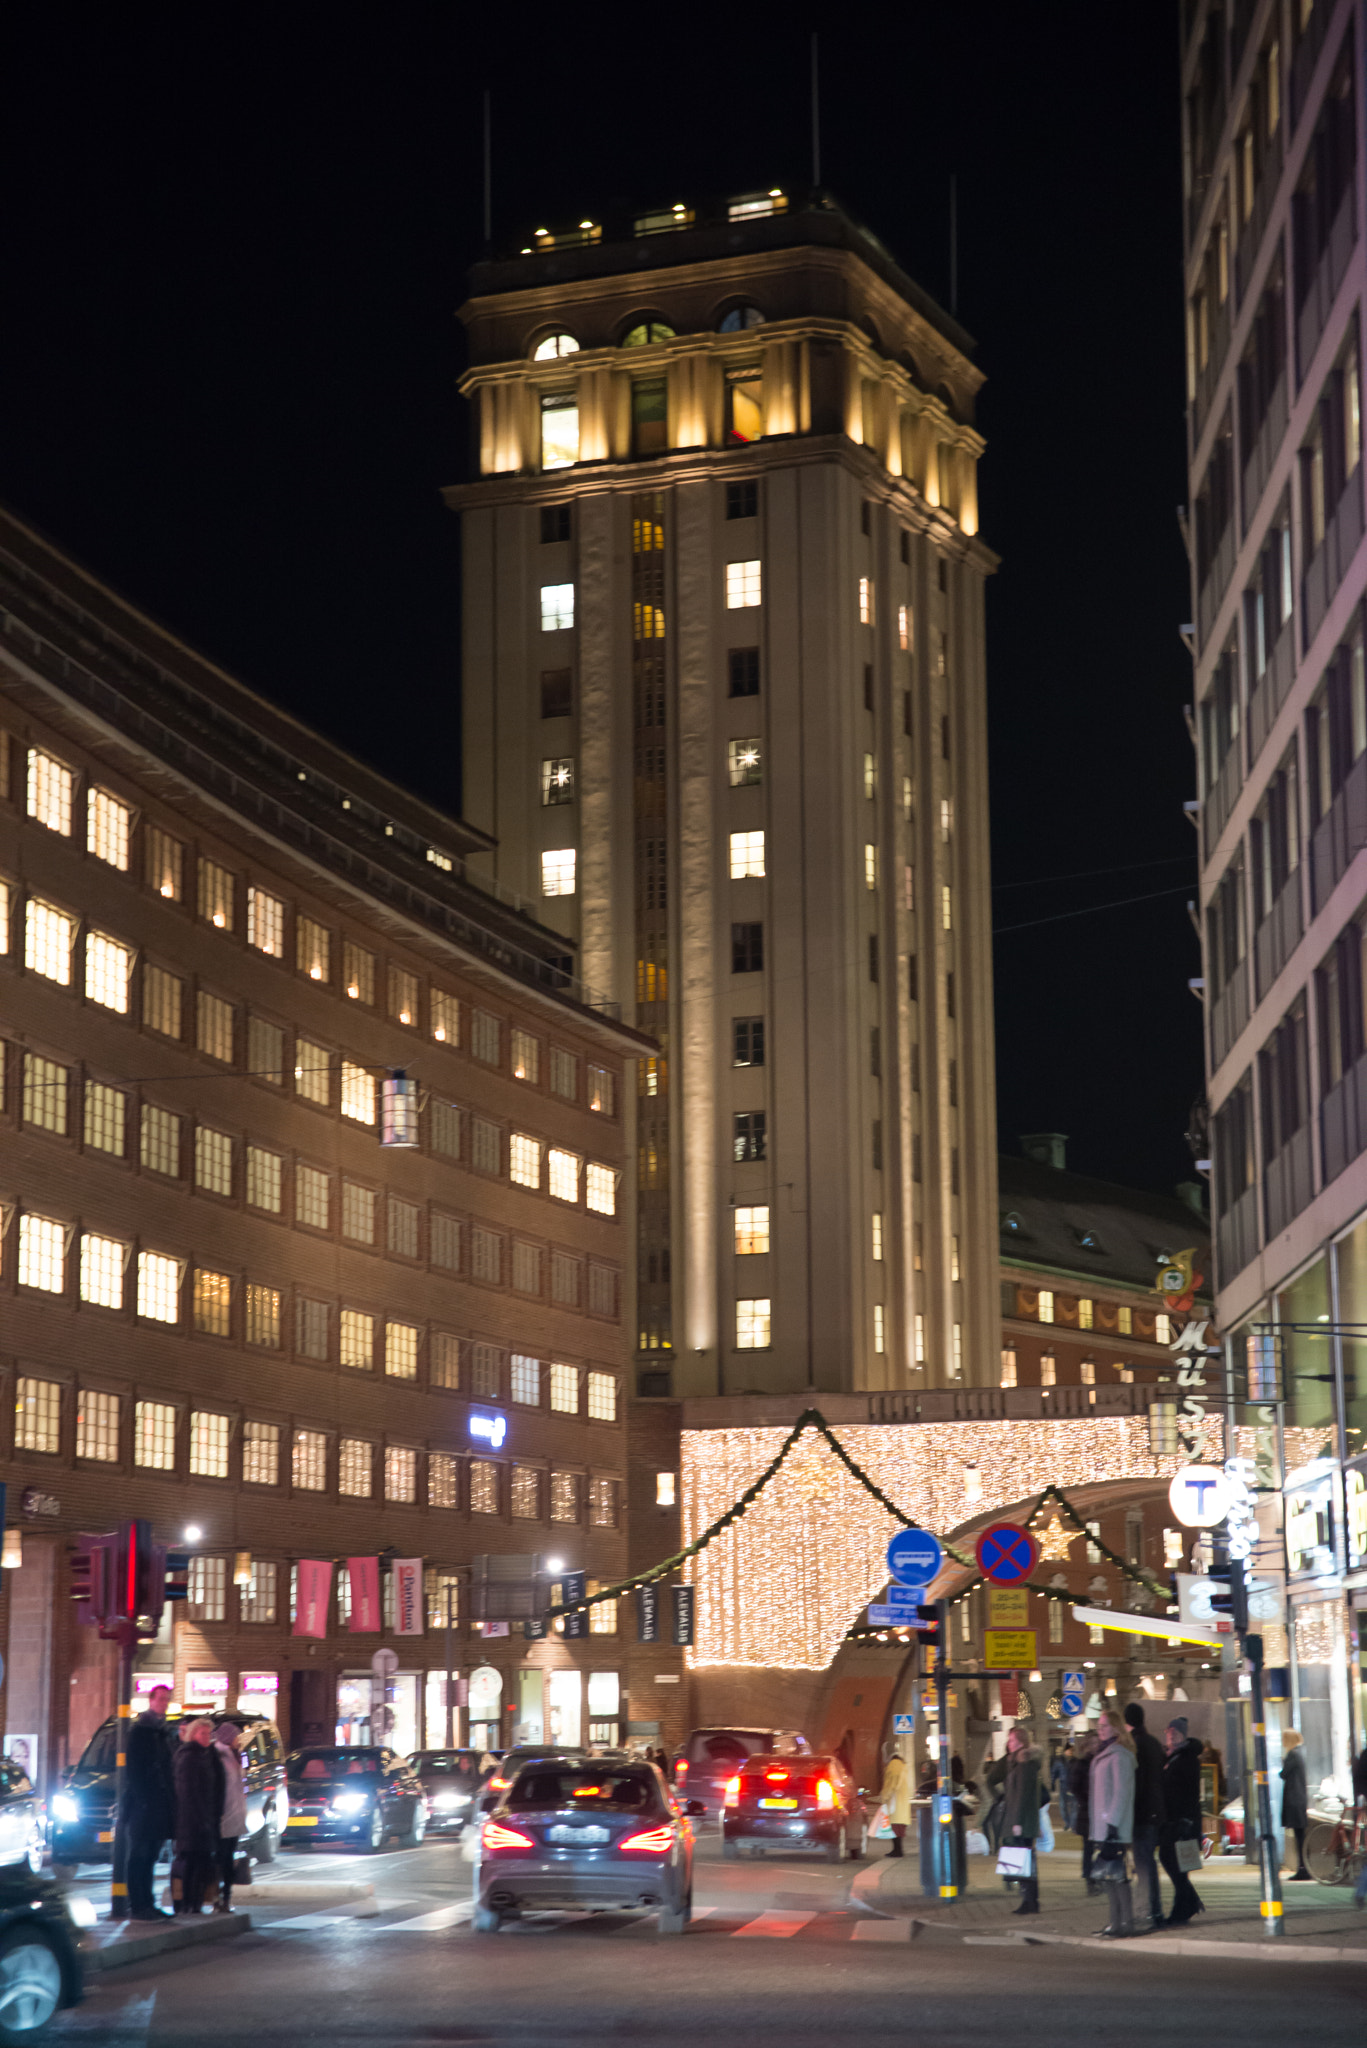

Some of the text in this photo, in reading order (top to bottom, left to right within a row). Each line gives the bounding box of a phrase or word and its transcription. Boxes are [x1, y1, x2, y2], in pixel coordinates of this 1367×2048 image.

[1185, 1480, 1217, 1515] T
[404, 1576, 416, 1630] Panduro
[642, 1586, 654, 1641] ALEWALDS
[678, 1590, 689, 1643] ALEWALDS
